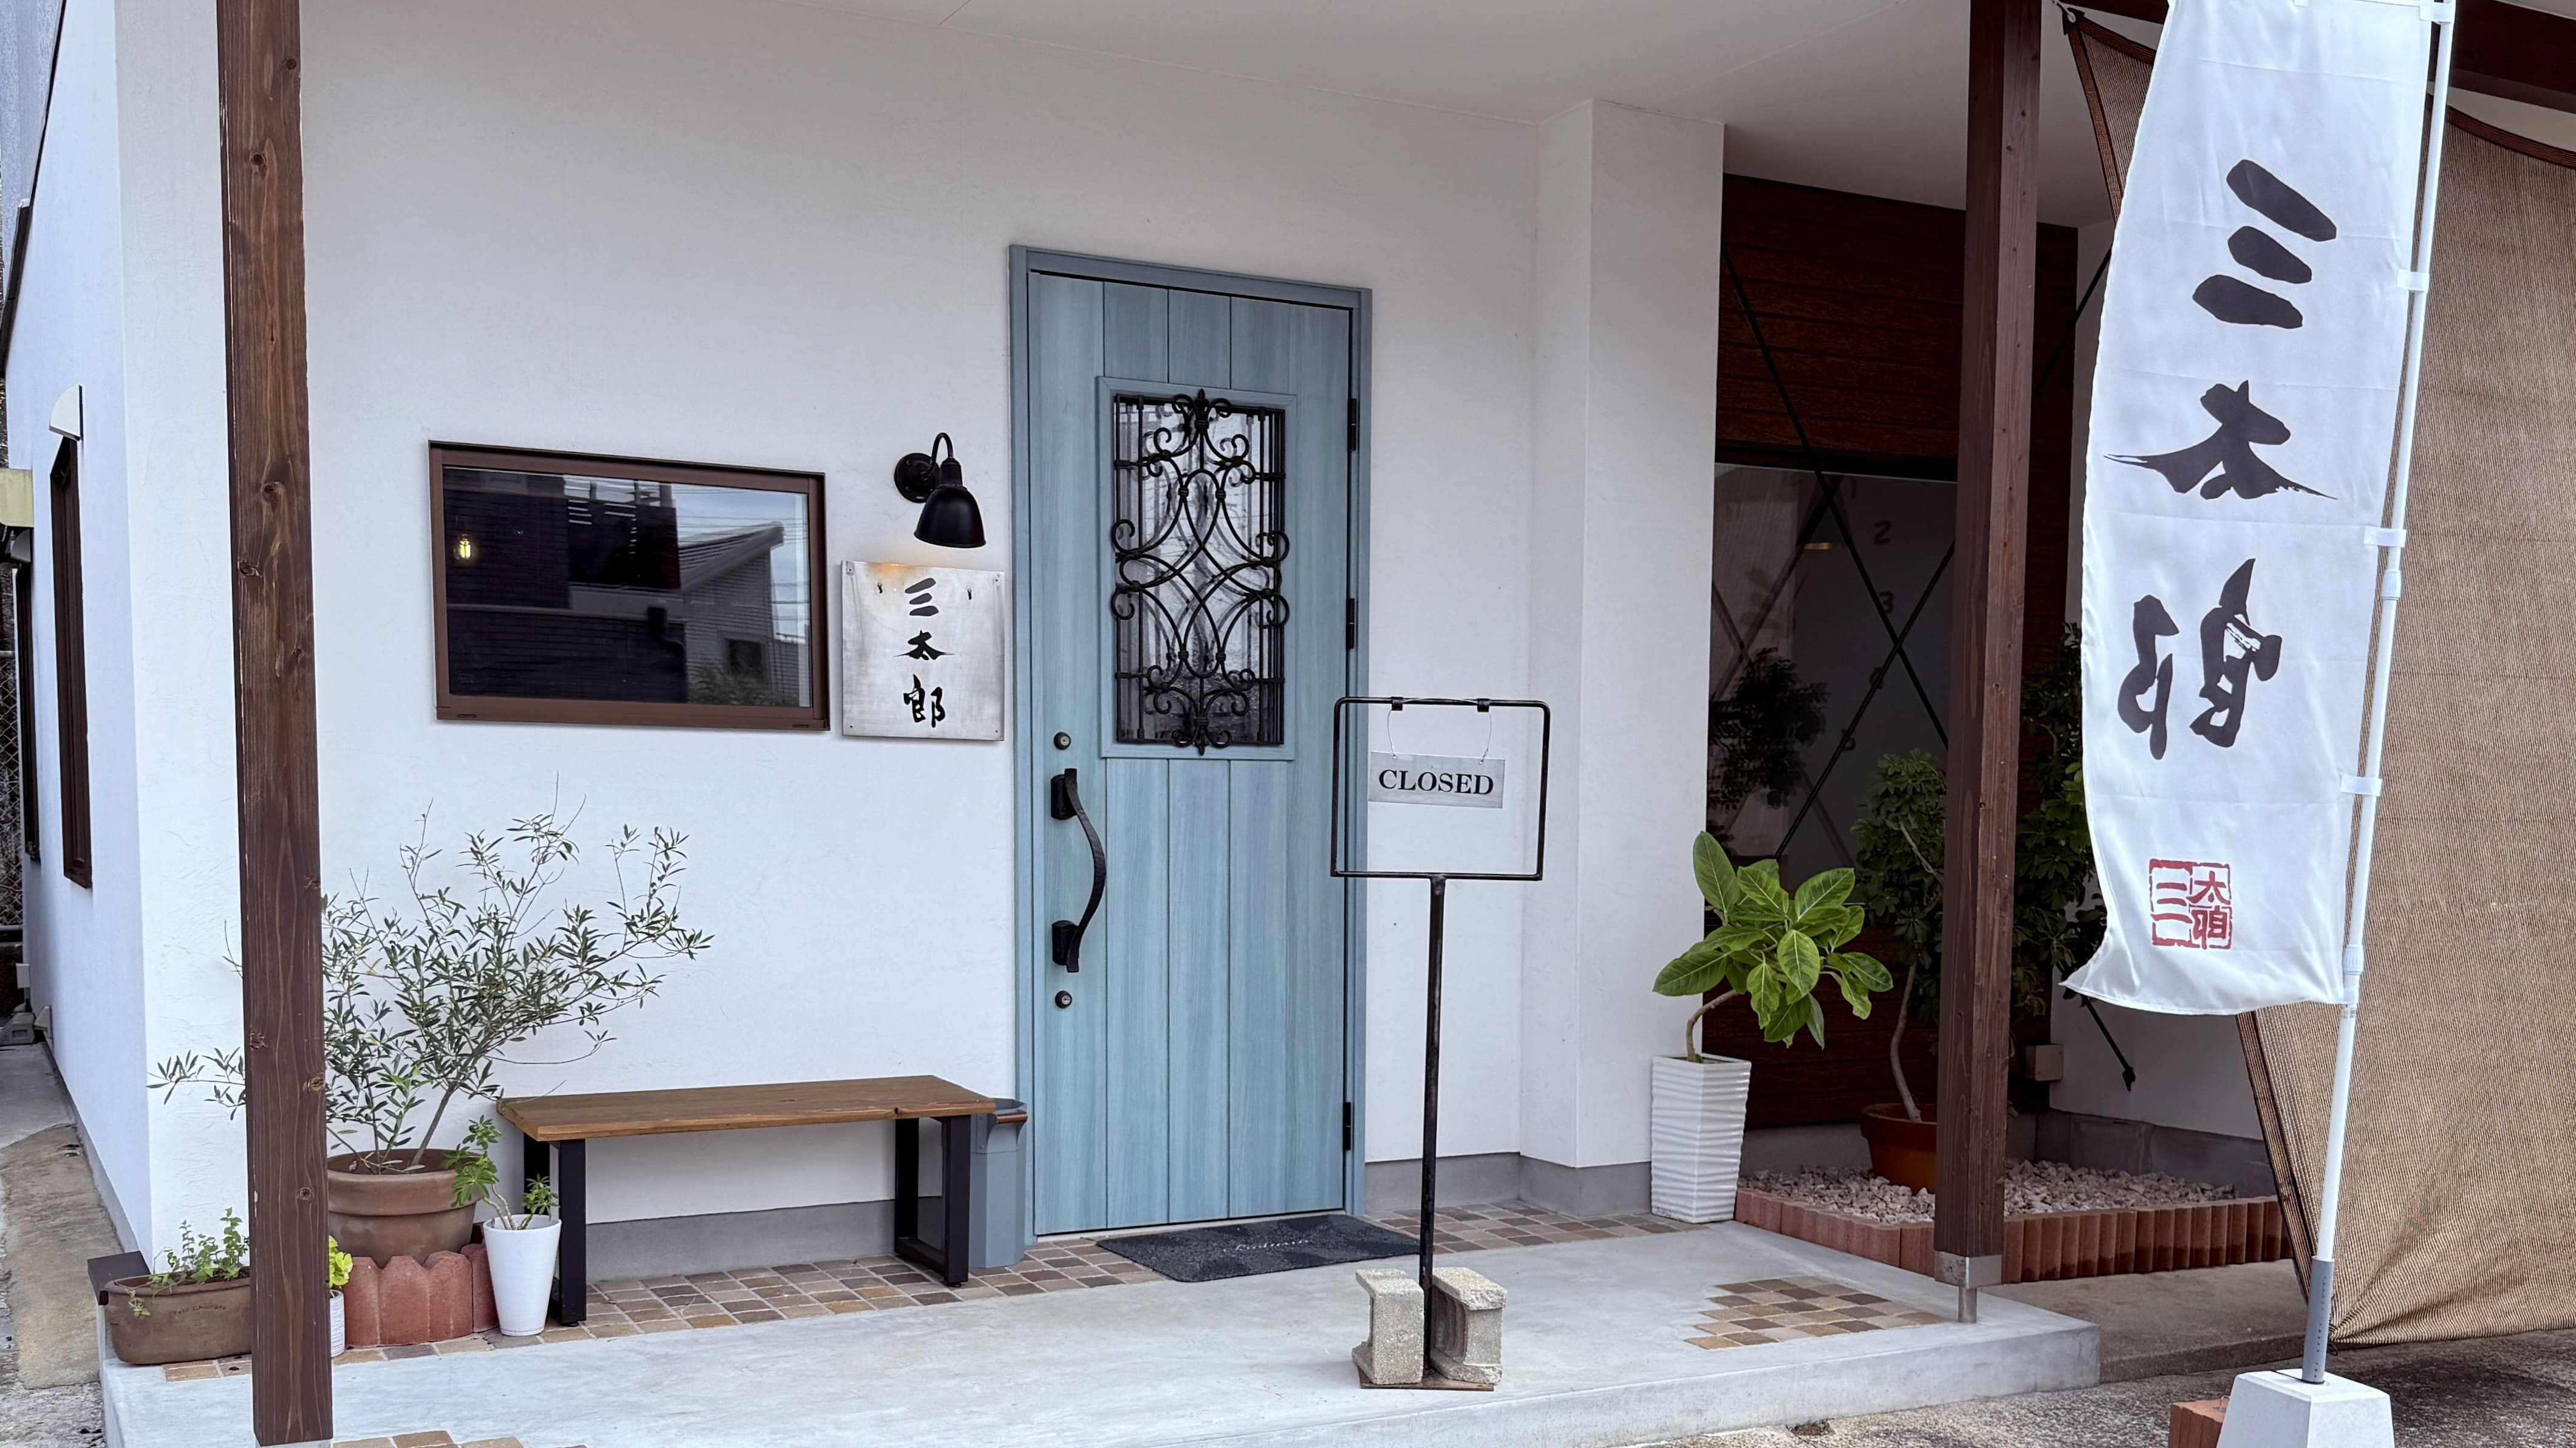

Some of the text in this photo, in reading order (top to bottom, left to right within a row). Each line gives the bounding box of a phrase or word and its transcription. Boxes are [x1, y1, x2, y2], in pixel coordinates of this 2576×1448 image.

[1874, 520, 1892, 545] 2
[894, 578, 955, 728] 三太郎
[1379, 769, 1494, 795] CLOSED
